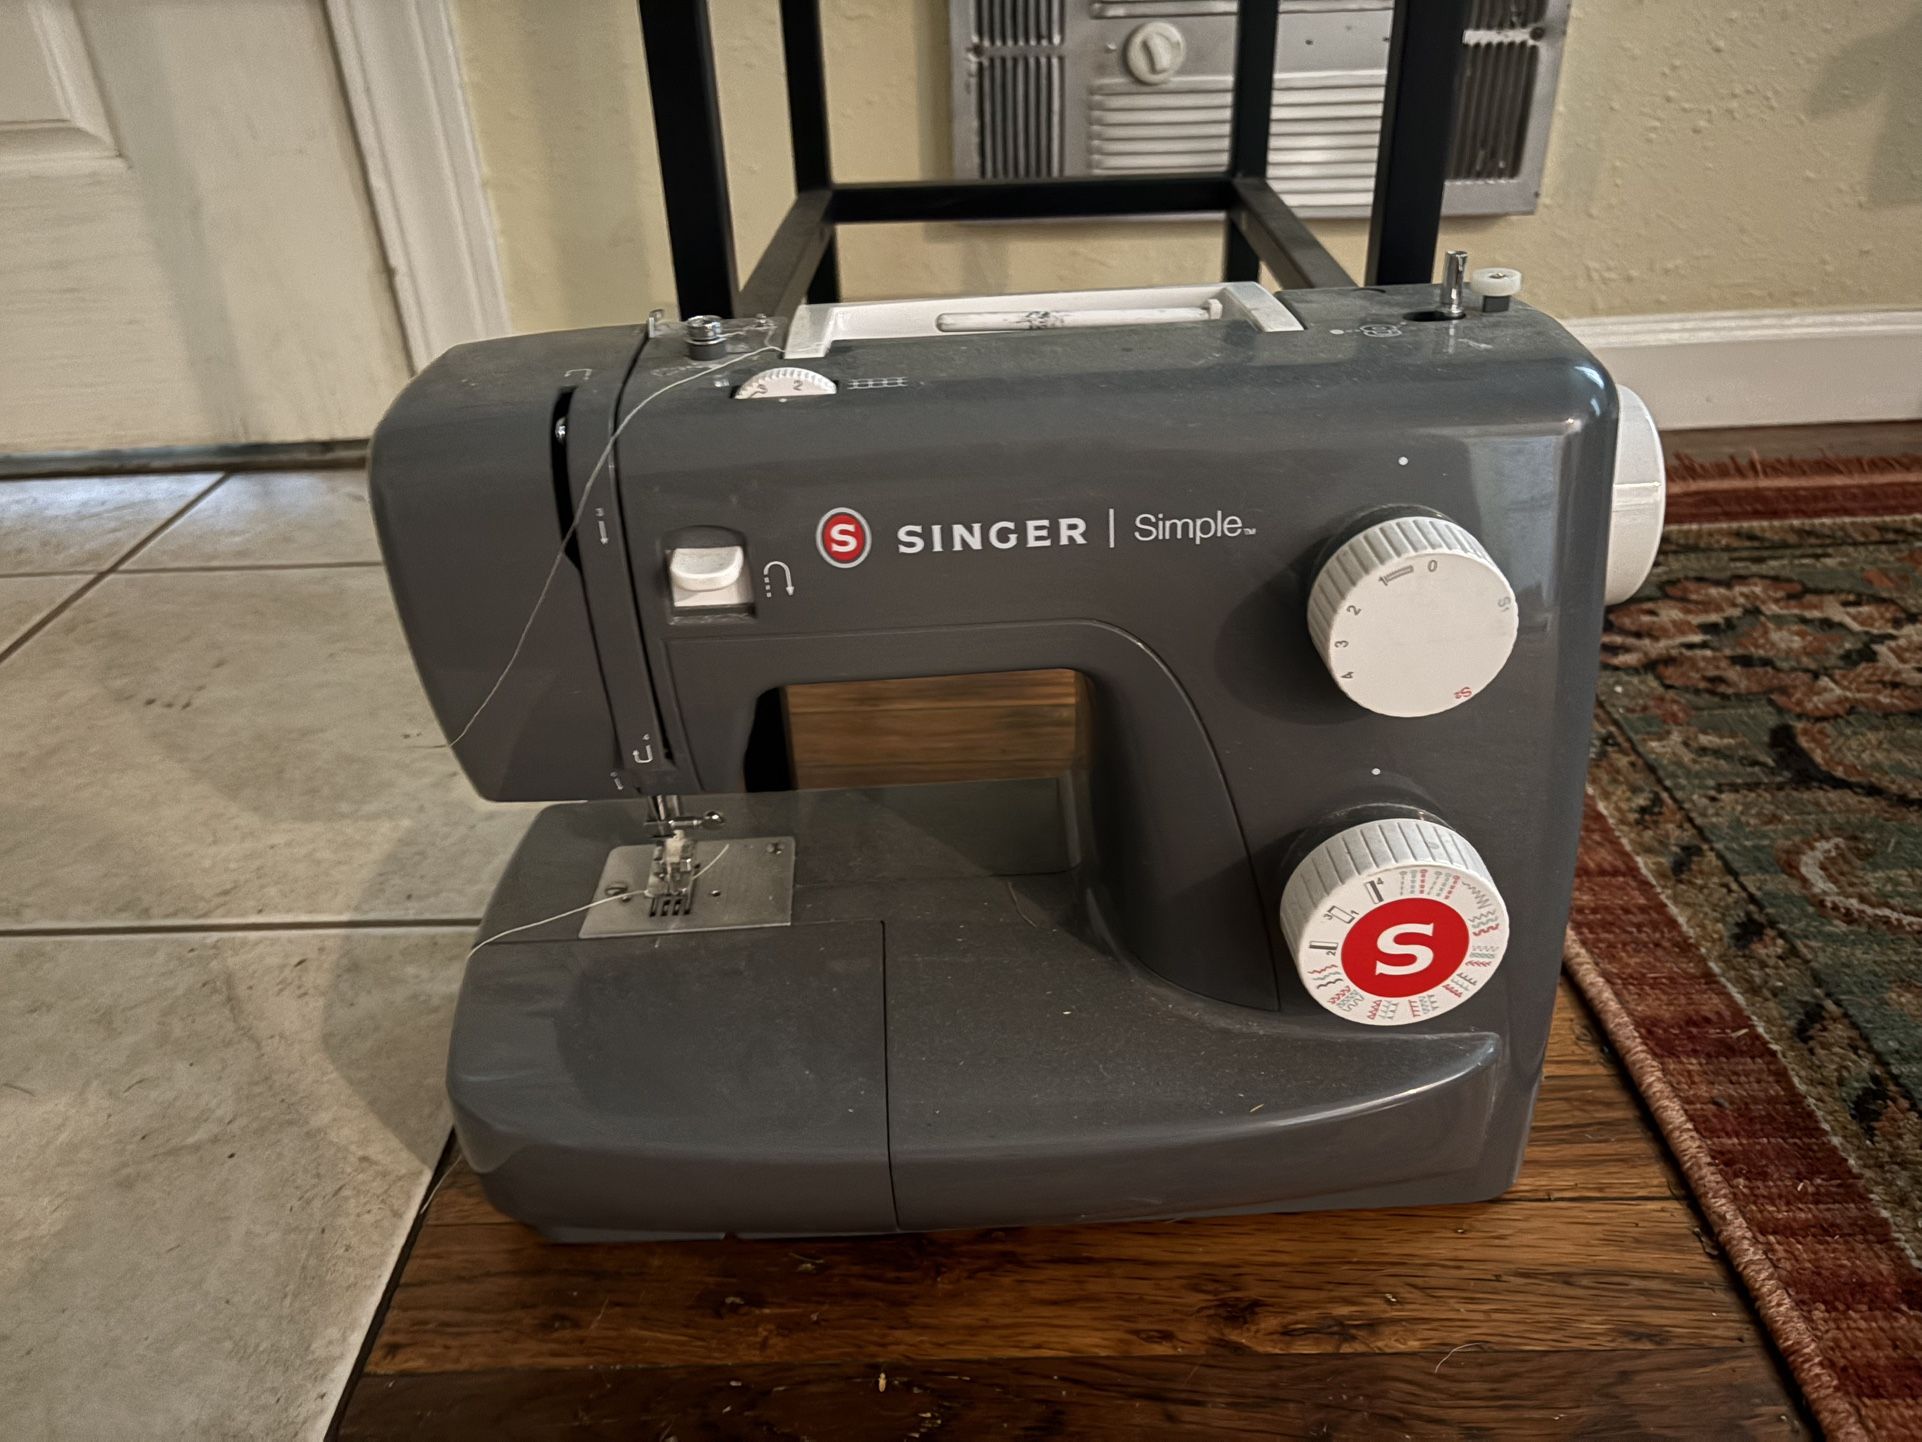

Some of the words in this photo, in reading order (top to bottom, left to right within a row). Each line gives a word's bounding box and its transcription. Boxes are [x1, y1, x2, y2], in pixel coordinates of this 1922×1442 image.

[793, 380, 803, 391] 2
[897, 517, 1088, 554] SINGER
[1134, 510, 1243, 545] Simple
[829, 523, 858, 553] S
[1428, 560, 1438, 572] 0
[1347, 605, 1361, 615] 2
[1334, 639, 1349, 649] 3
[1341, 671, 1354, 680] 4
[1375, 923, 1434, 976] S
